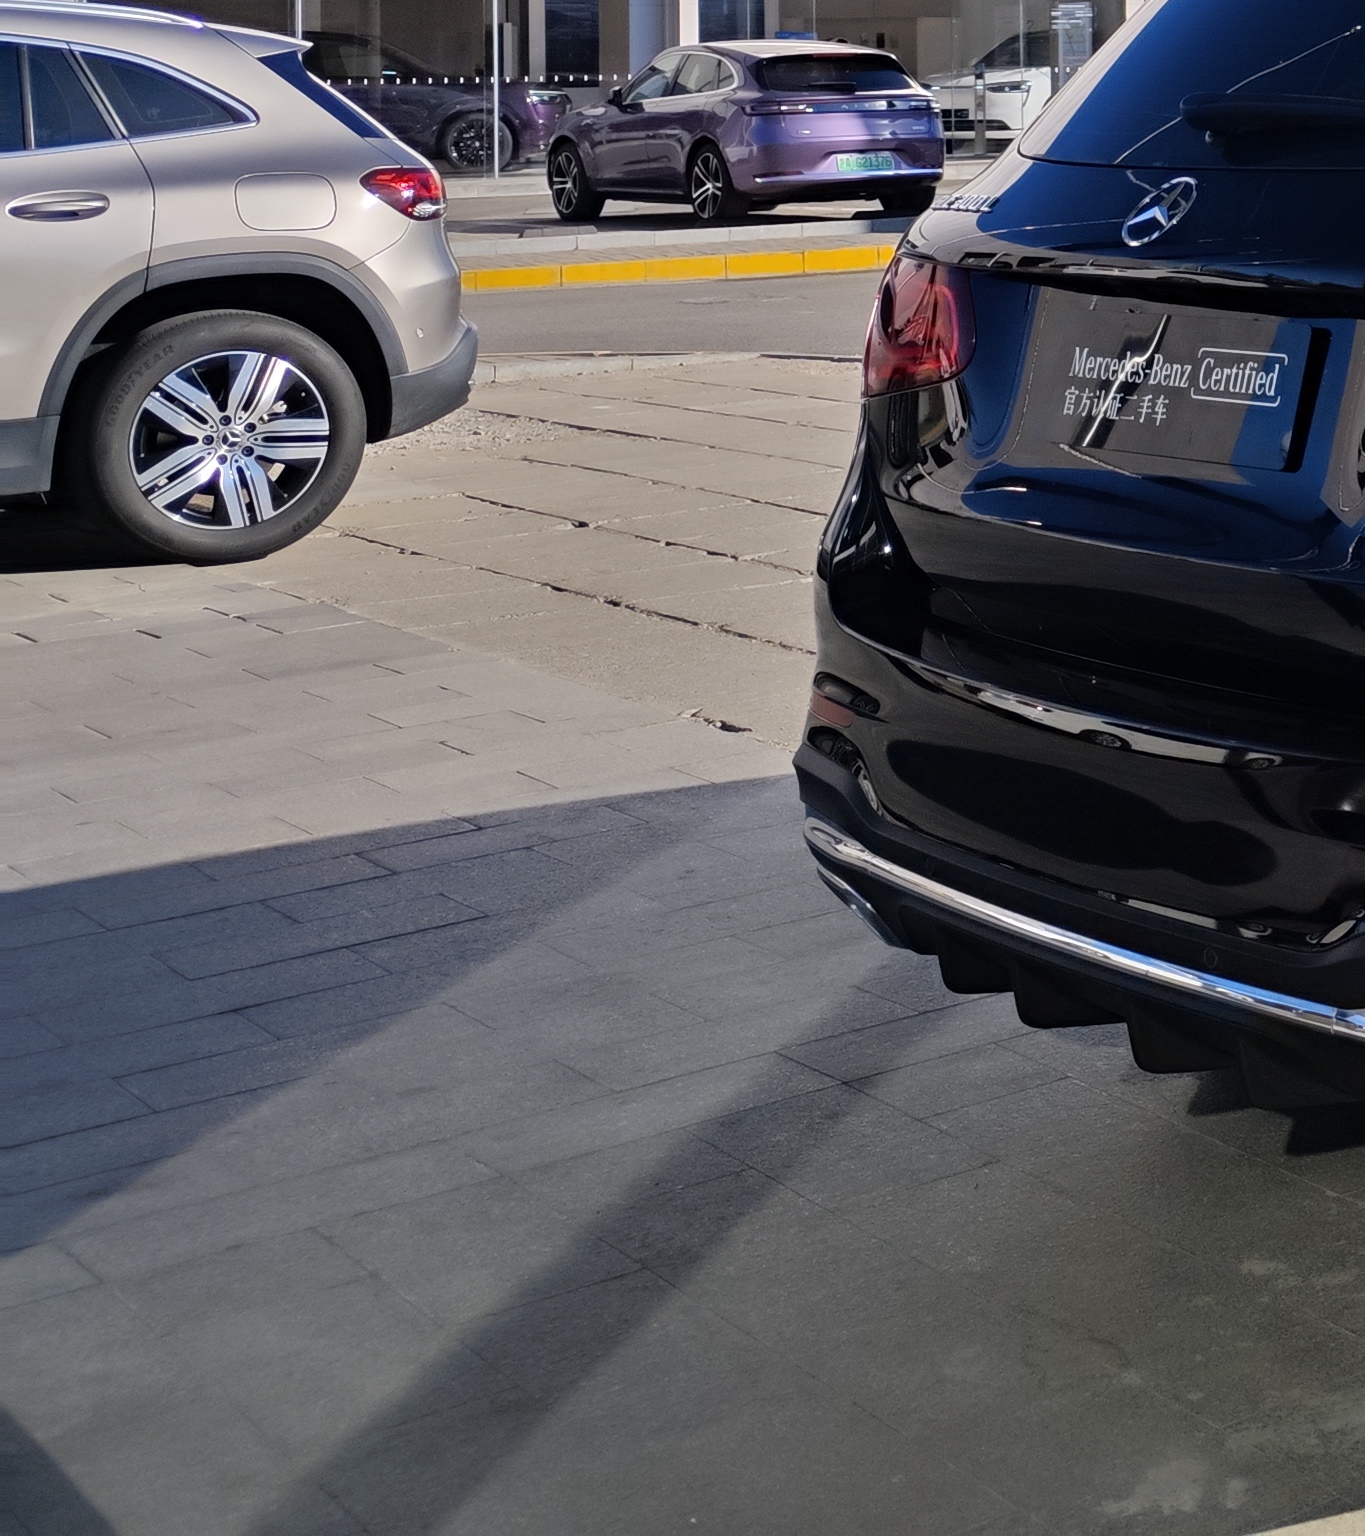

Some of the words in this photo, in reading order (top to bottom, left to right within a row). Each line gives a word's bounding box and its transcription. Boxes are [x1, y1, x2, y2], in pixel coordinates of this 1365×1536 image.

[1068, 346, 1190, 390] Mercedes-Benz
[1199, 355, 1280, 397] Certified
[1062, 386, 1168, 427] 官方认证二手车
